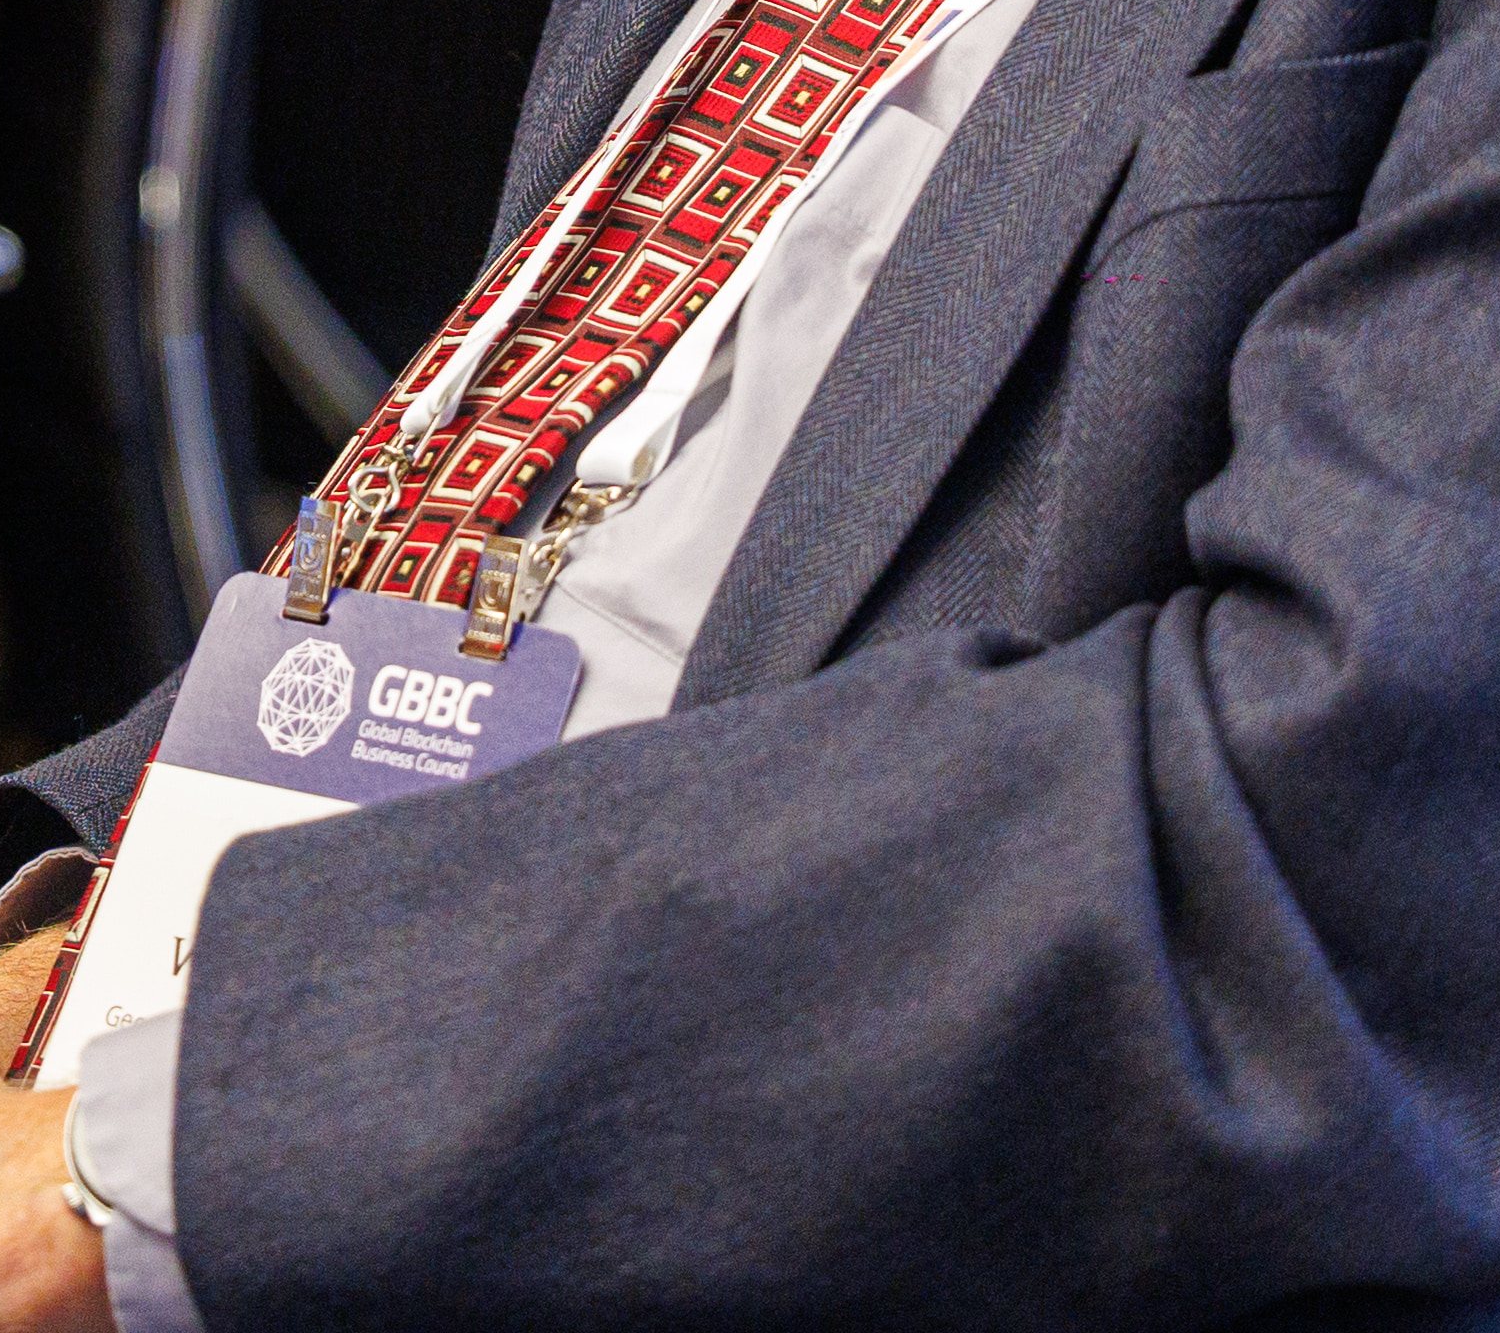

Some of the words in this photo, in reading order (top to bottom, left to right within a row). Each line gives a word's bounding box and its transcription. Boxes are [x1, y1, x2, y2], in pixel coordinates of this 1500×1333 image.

[367, 664, 495, 736] GBBC
[351, 739, 416, 770] Business
[415, 752, 470, 780] Council
[358, 718, 404, 745] Global
[400, 726, 475, 760] Blockchain
